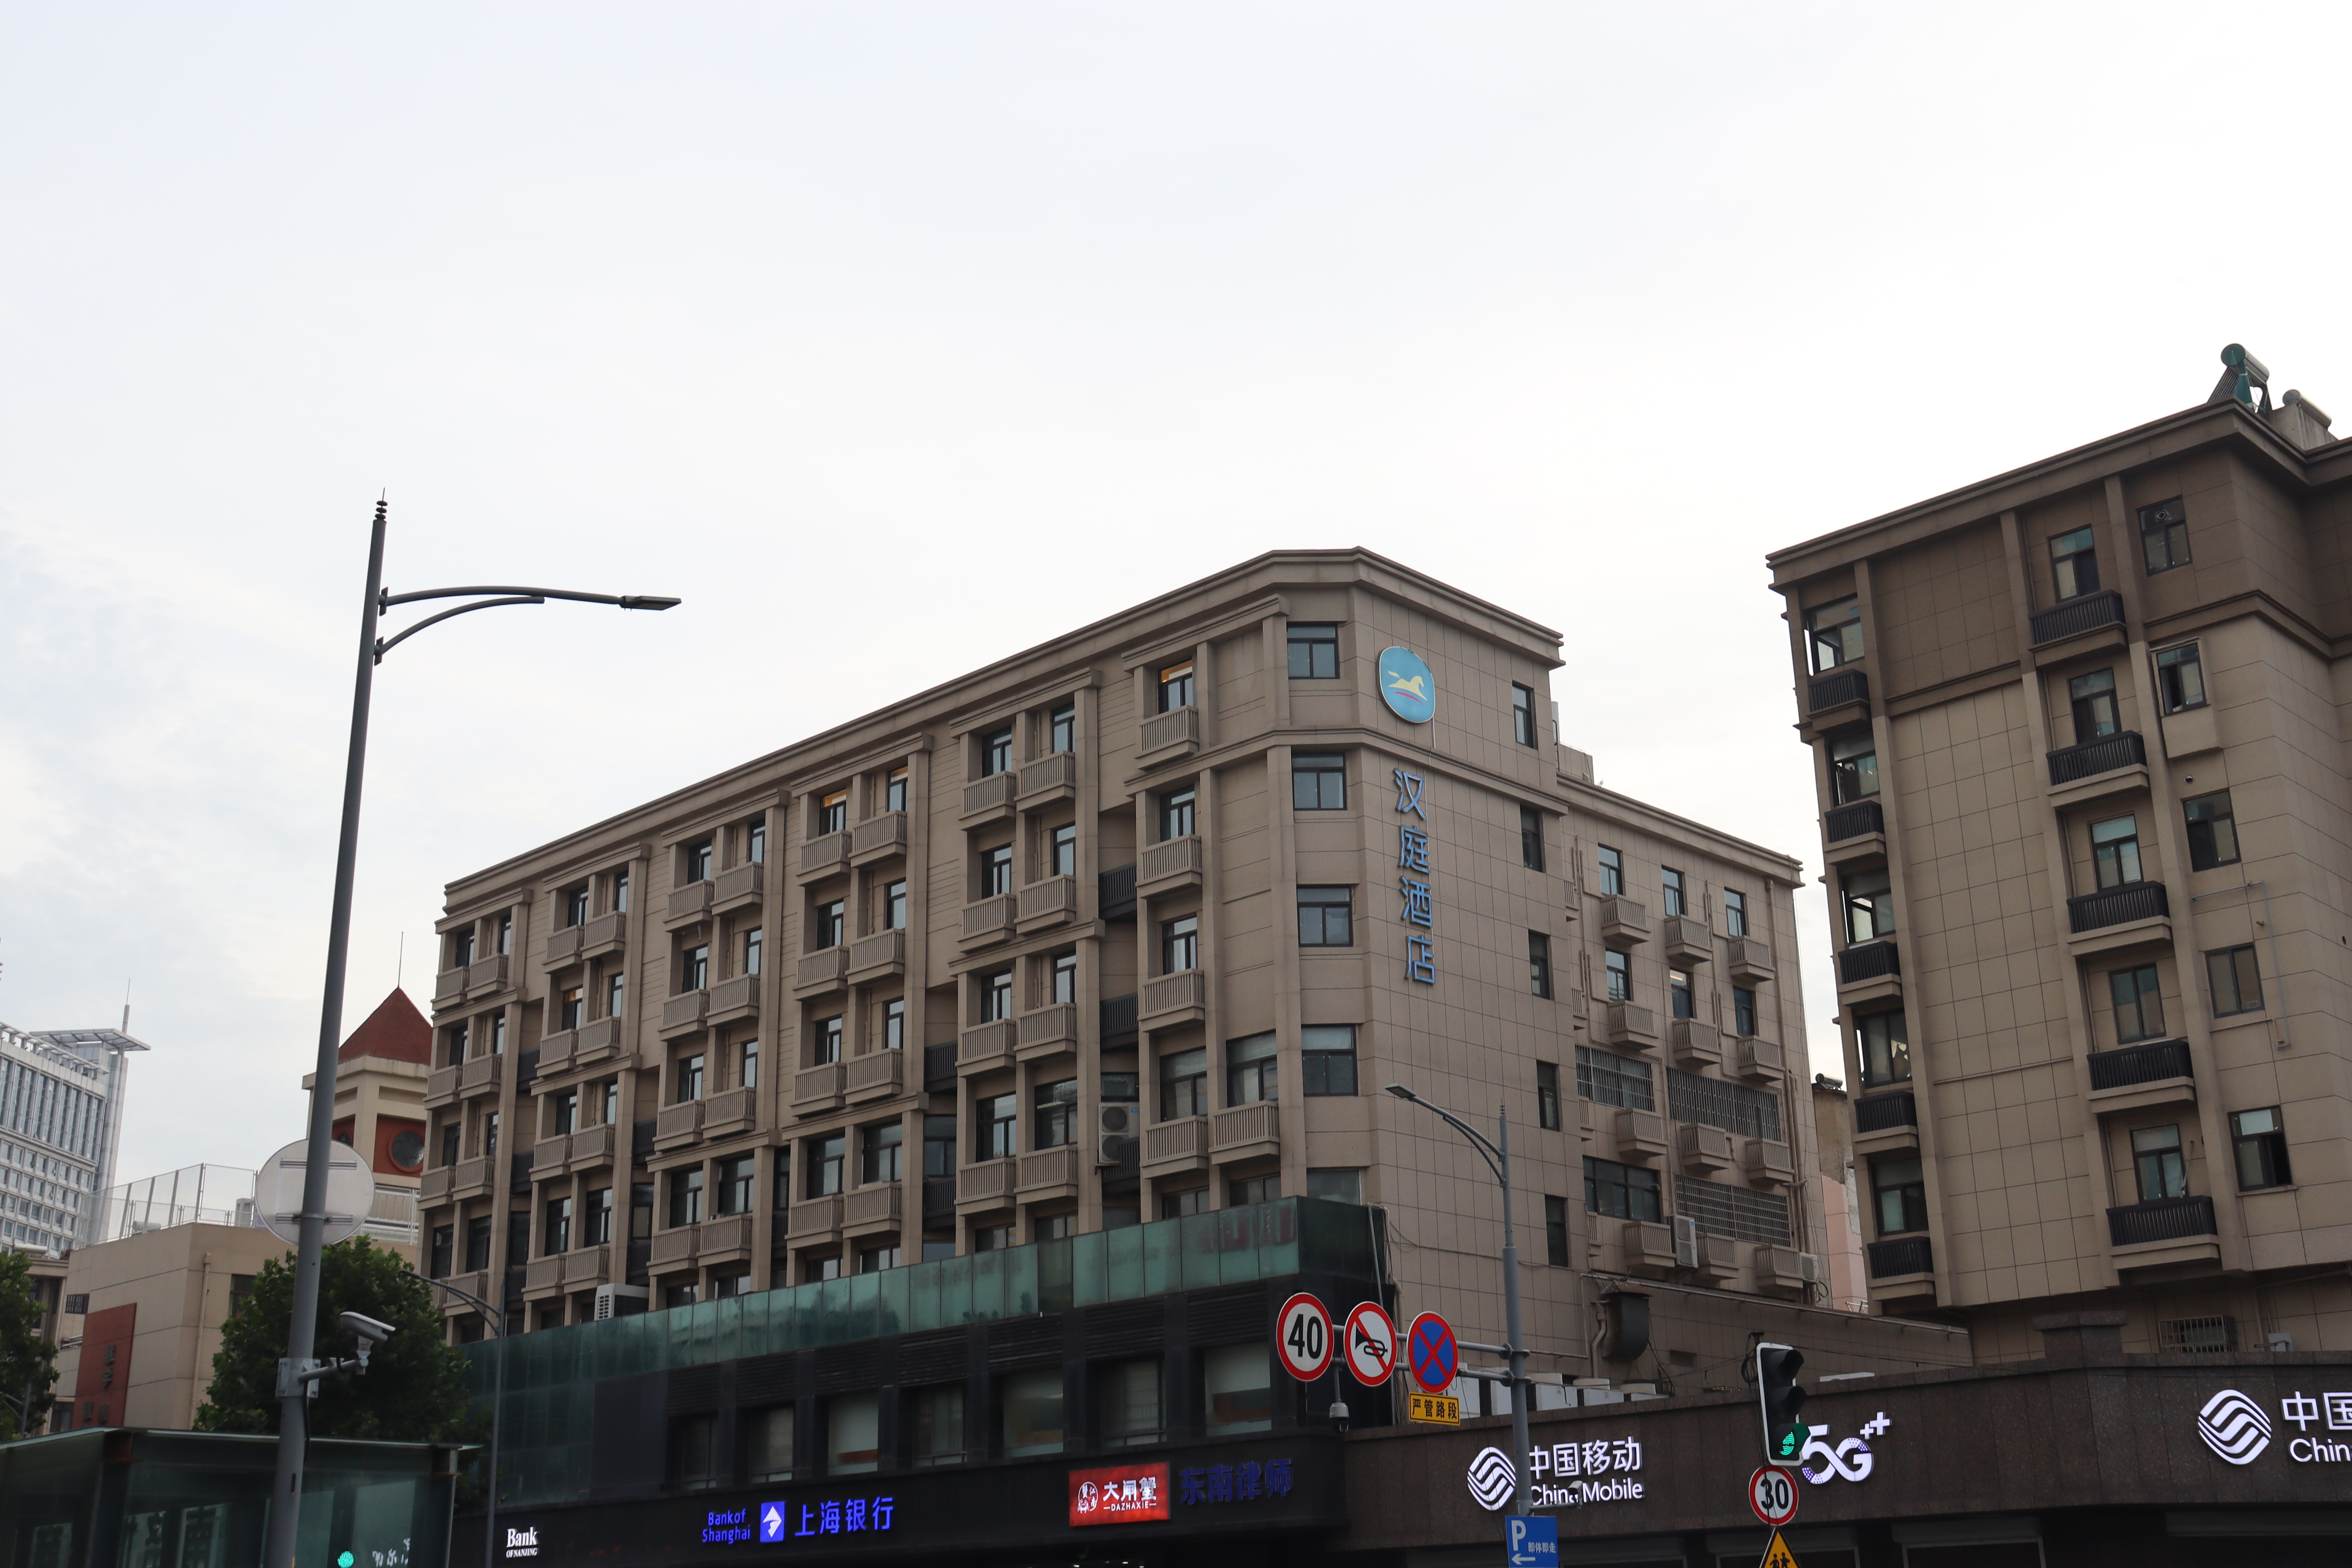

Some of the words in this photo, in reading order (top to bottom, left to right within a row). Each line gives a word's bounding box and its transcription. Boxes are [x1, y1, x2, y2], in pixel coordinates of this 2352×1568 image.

[1393, 768, 1435, 985] 汉庭酒店
[1287, 1313, 1323, 1359] 40
[1412, 1398, 1457, 1420] 严管路段
[1529, 1436, 1642, 1480] 中国移动
[2289, 1437, 2352, 1462] Chin
[1103, 1477, 1157, 1502] 大闸蟹
[1180, 1459, 1291, 1505] 东南律师
[1582, 1477, 1644, 1503] Mobile
[1760, 1478, 1789, 1509] 30
[795, 1497, 893, 1537] 上海银行
[506, 1526, 538, 1548] Bank
[702, 1524, 750, 1544] Shanghai
[1511, 1520, 1526, 1551] P
[1528, 1541, 1556, 1553] 即停即走
